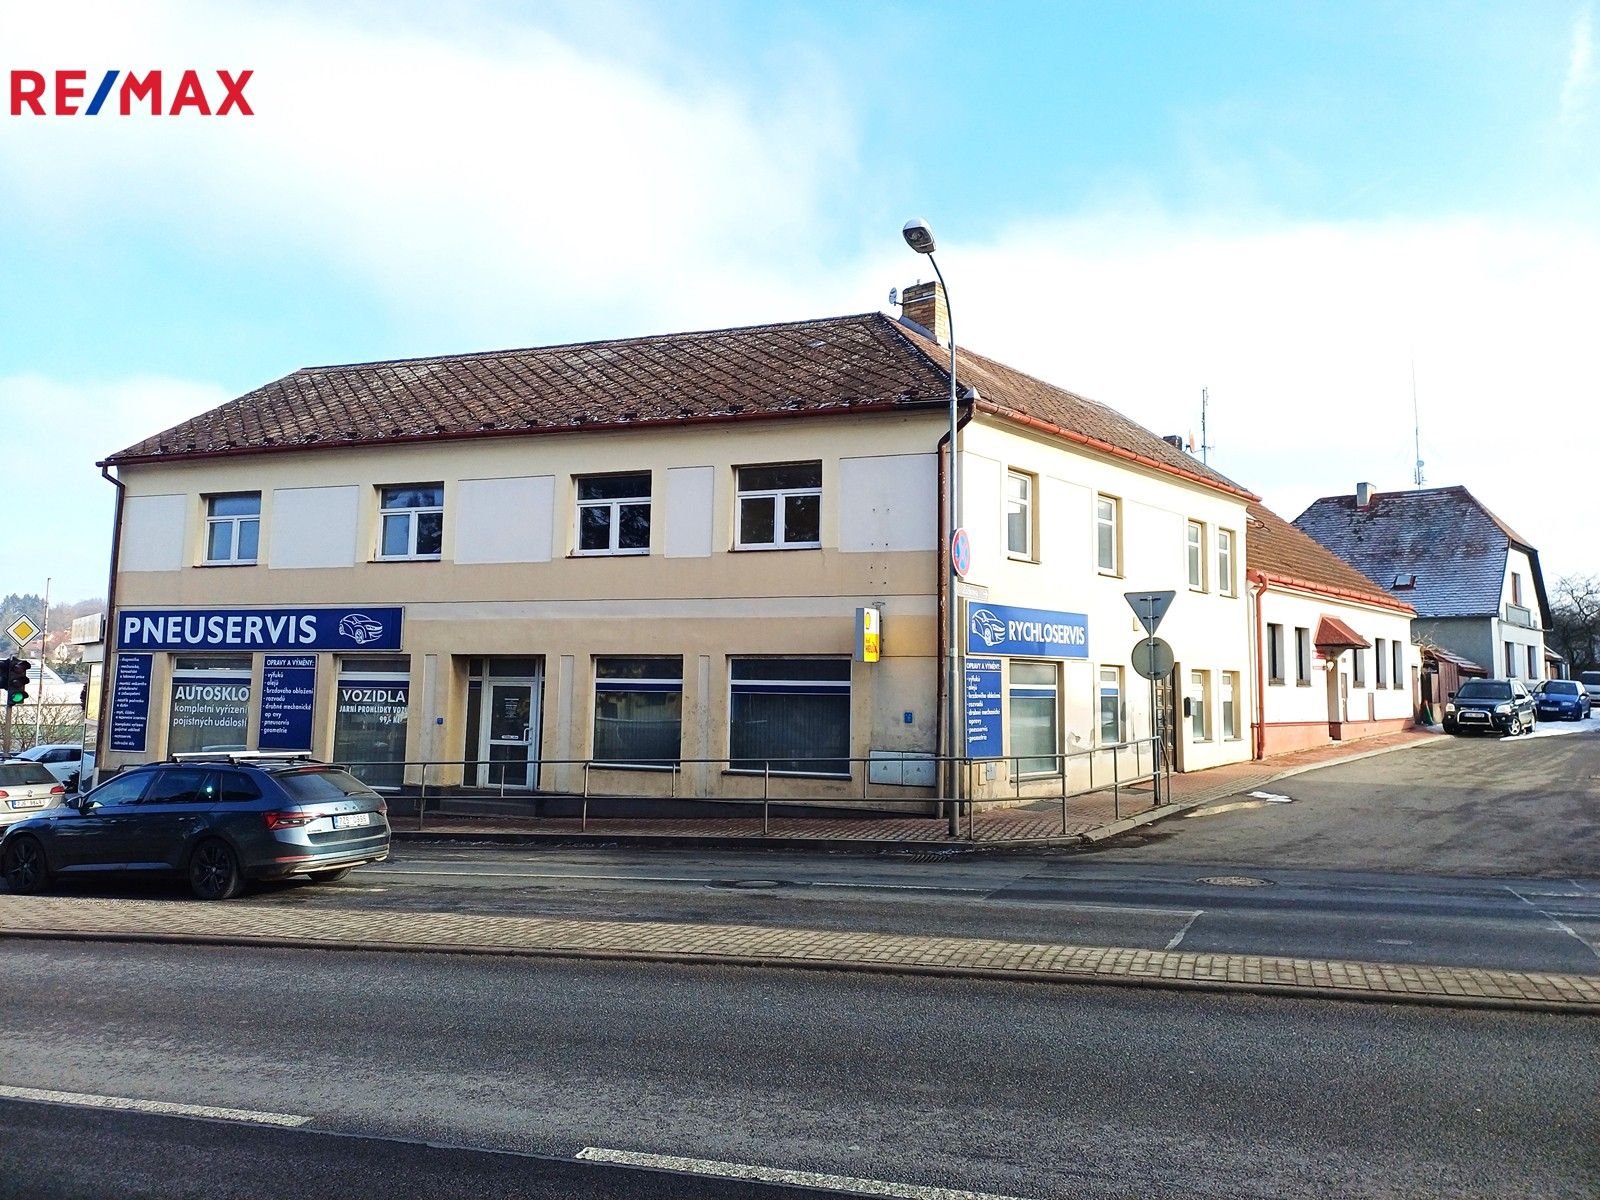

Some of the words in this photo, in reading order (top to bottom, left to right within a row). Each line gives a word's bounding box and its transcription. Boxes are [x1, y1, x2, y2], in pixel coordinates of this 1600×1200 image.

[123, 615, 317, 644] PNEUSERVIS
[1008, 620, 1085, 645] RYCHLOSERVIS
[175, 686, 249, 701] AUTOSKLO
[342, 689, 406, 703] VOZIDLA
[174, 702, 215, 714] kompletní
[339, 704, 357, 713] JARNÍ
[357, 704, 391, 714] PROHLÍDKY
[173, 717, 214, 728] pojistných
